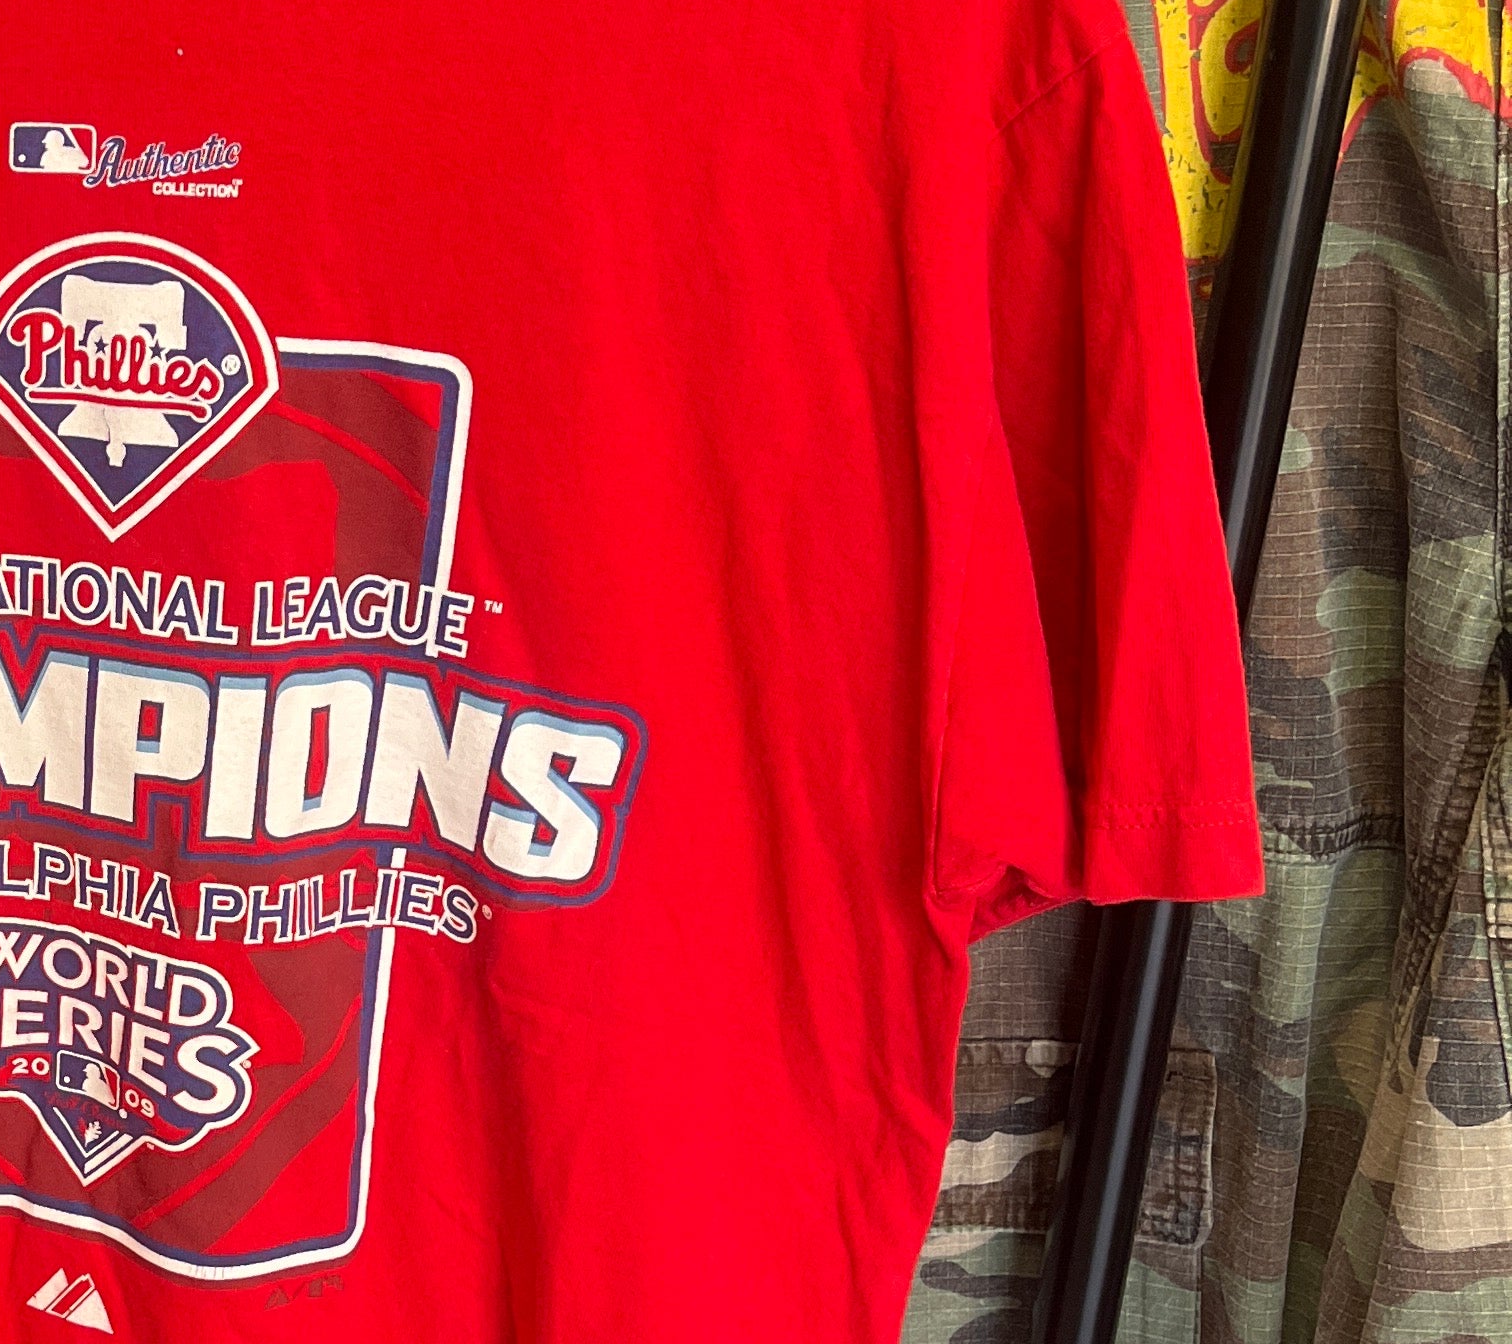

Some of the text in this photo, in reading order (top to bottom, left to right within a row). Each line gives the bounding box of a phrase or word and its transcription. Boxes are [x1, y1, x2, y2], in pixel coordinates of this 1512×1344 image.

[83, 134, 241, 188] Authentic
[152, 181, 239, 198] COLLECTION
[7, 307, 225, 404] Phillies
[252, 577, 476, 656] LEAGUE
[195, 868, 480, 944] PHILLIES
[11, 1057, 51, 1077] 20
[124, 1088, 155, 1119] 09
